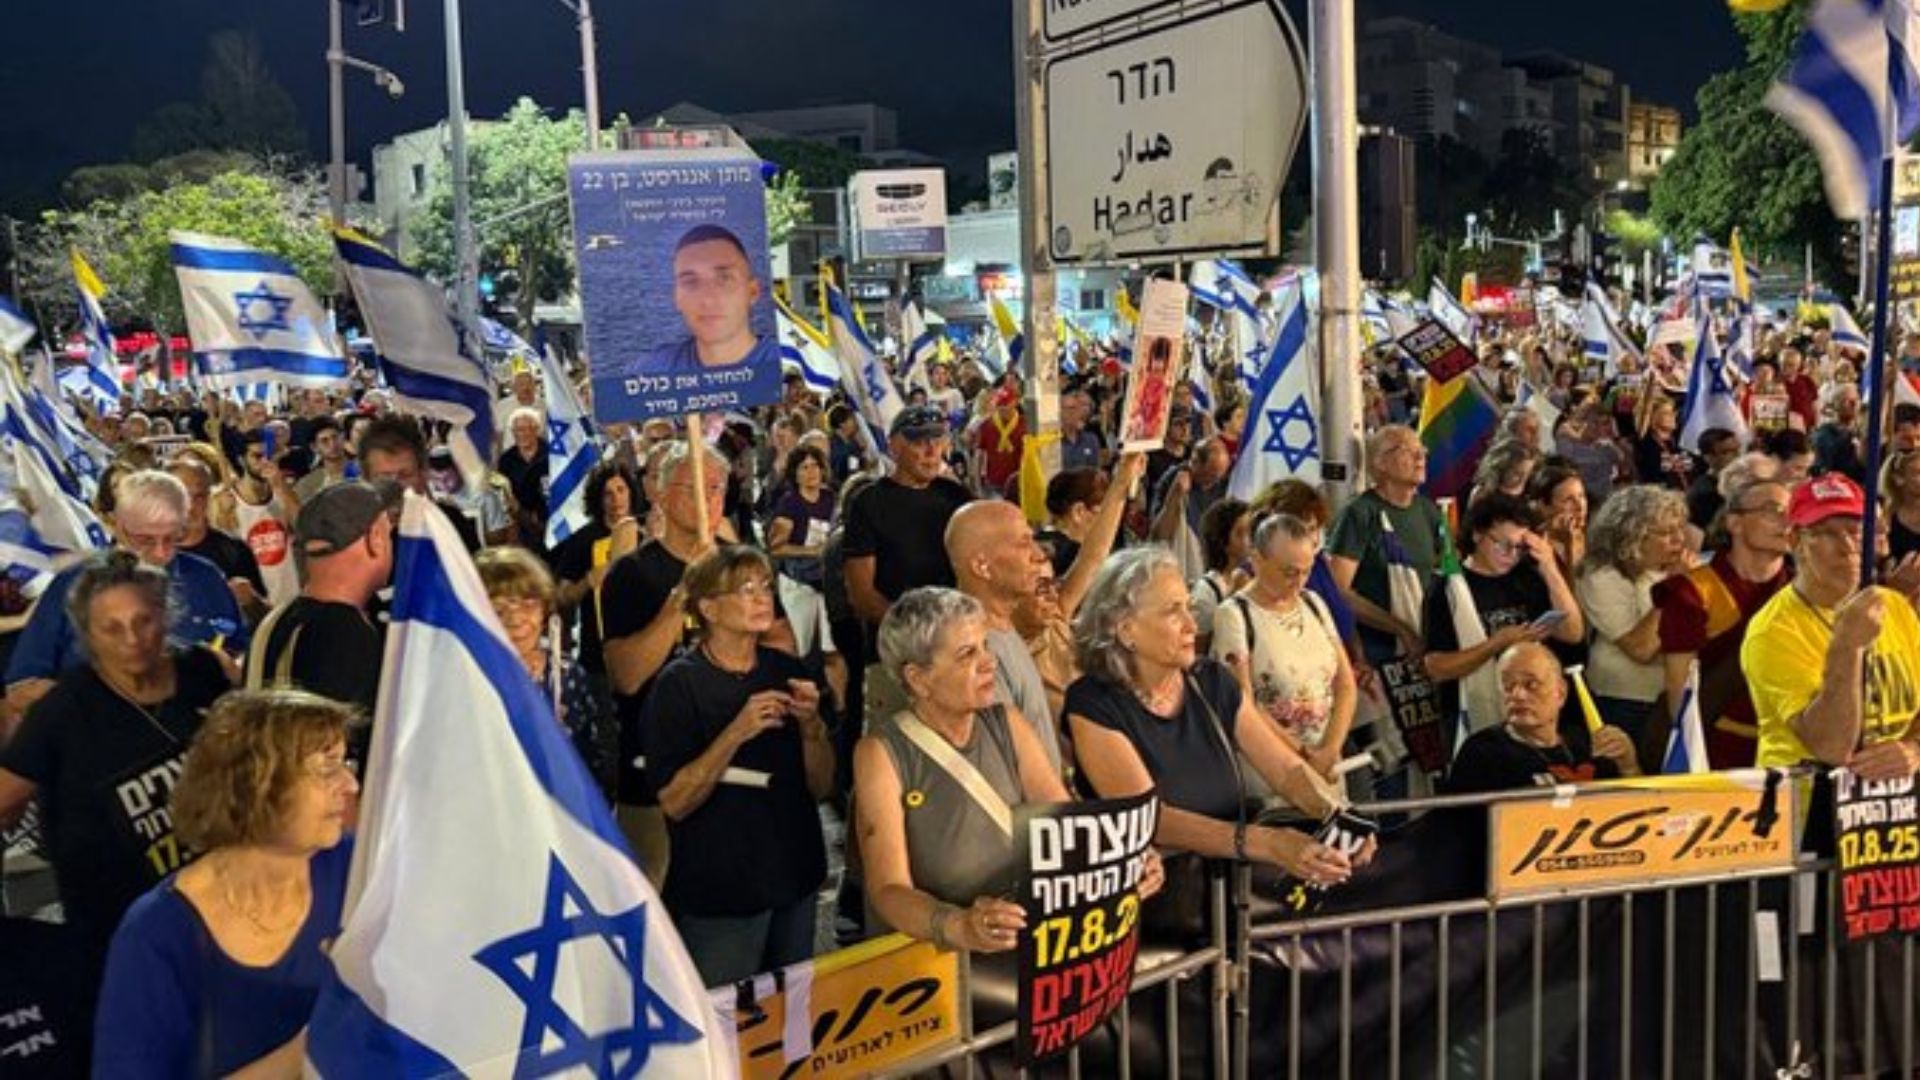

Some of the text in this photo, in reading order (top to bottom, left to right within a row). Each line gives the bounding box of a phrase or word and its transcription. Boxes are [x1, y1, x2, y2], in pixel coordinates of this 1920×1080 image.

[1107, 57, 1175, 104] הדר
[718, 166, 752, 187] מתן
[1112, 130, 1173, 182] هدار
[582, 171, 603, 190] 22
[611, 171, 630, 191] בן
[624, 366, 754, 396] להחזיר את כולם
[133, 807, 174, 841] רוף
[1029, 796, 1159, 872] עוצרים
[1840, 827, 1920, 870] 17.8.25
[1031, 866, 1122, 916] הטירוף
[1032, 894, 1140, 968] 17.8.2
[1032, 931, 1138, 1024] עוצרים
[901, 1016, 942, 1040] ציוד
